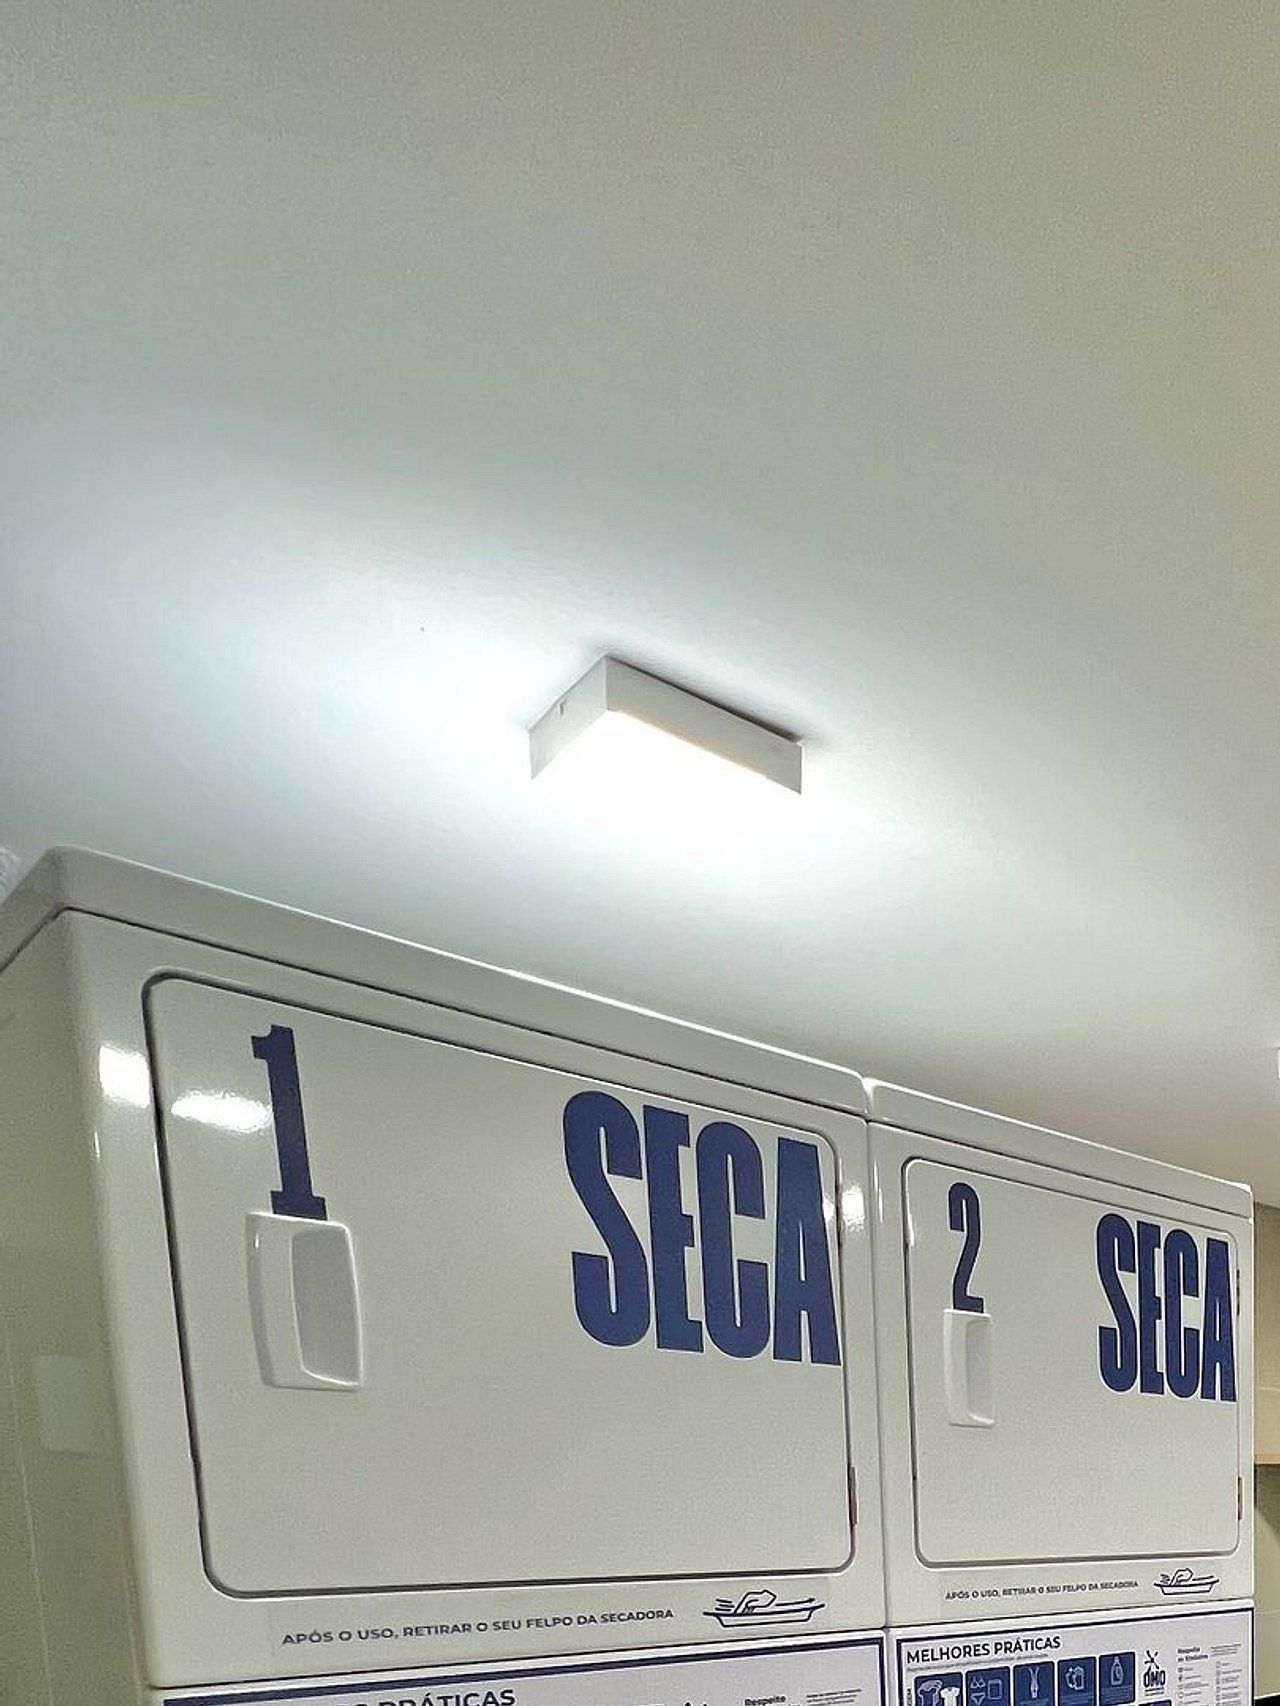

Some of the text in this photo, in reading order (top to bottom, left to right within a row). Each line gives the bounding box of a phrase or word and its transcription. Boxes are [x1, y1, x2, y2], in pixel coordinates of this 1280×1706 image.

[251, 1024, 327, 1221] 1
[562, 1090, 841, 1366] SECA
[948, 1182, 984, 1313] 2
[1096, 1213, 1237, 1402] SECA
[282, 1609, 674, 1645] APÓS O USO, RETIRAR O SEU FELPO DA SECADORA
[945, 1590, 970, 1600] APÓS
[972, 1590, 979, 1599] O
[1038, 1586, 1044, 1594] O
[907, 1643, 990, 1664] MELHORES
[994, 1635, 1061, 1655] PRÁTICAS
[1143, 1669, 1166, 1688] OMO
